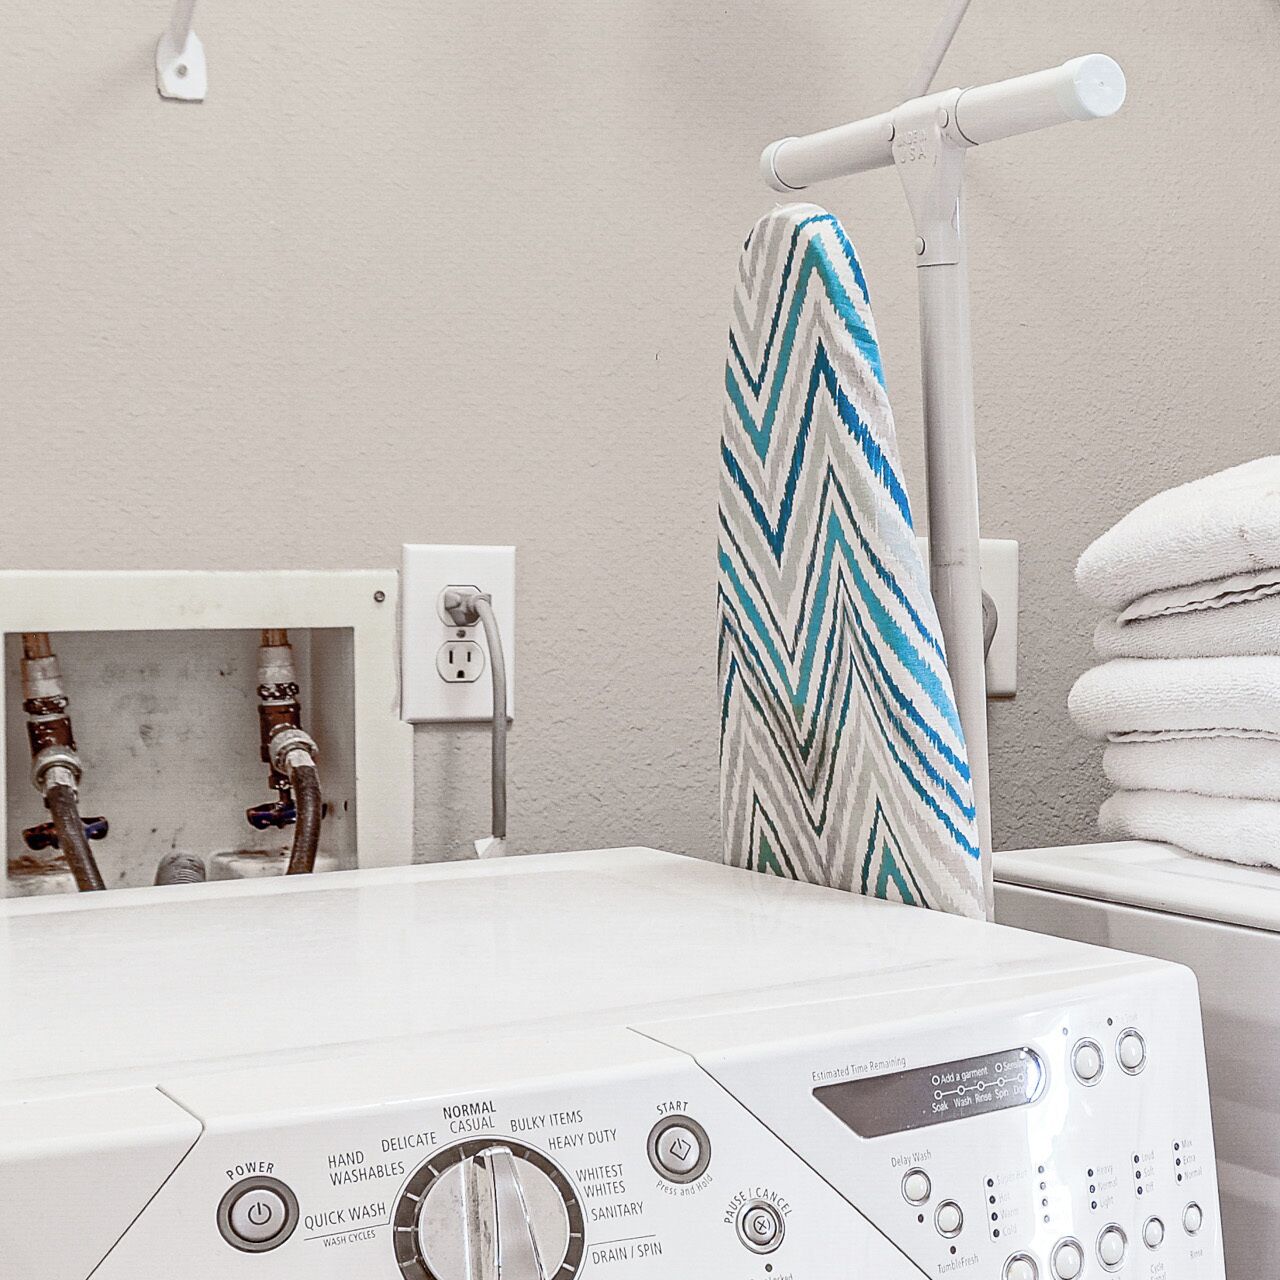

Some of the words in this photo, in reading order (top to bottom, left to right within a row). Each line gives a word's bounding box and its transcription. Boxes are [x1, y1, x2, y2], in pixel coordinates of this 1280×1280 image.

[812, 1065, 850, 1082] Estimated
[851, 1064, 868, 1075] Time
[869, 1057, 906, 1072] Remaining
[940, 1072, 954, 1084] Add
[961, 1067, 988, 1081] garment
[443, 1100, 497, 1120] NORMAL
[656, 1100, 688, 1115] START
[932, 1100, 949, 1113] Soak
[953, 1097, 972, 1108] Wash
[974, 1093, 992, 1104] Rinse
[995, 1088, 1009, 1099] Spin
[450, 1116, 496, 1134] CASUAL
[510, 1116, 545, 1132] BULKY
[549, 1110, 583, 1127] ITEMS
[381, 1131, 437, 1152] DELICATE
[548, 1134, 584, 1151] HEAVY
[588, 1128, 617, 1144] DUTY
[328, 1150, 364, 1168] HAND
[890, 1154, 912, 1168] Delay
[912, 1148, 932, 1163] Wash
[225, 1161, 274, 1180] POWER
[329, 1161, 405, 1186] WASHABLES
[575, 1164, 623, 1182] WHITEST
[583, 1180, 626, 1198] WHITES
[656, 1180, 678, 1196] Press
[680, 1185, 695, 1196] and
[697, 1174, 713, 1191] Hold
[591, 1201, 644, 1221] SANITARY
[723, 1191, 746, 1224] PAUSE
[755, 1187, 793, 1217] CANCEL
[304, 1210, 345, 1230] QUICK
[348, 1202, 387, 1222] WASH
[323, 1236, 347, 1248] WASH
[348, 1230, 376, 1243] CYCLES
[592, 1247, 628, 1265] DRAIN
[637, 1242, 663, 1258] SPIN
[937, 1253, 979, 1274] TumbleFresh
